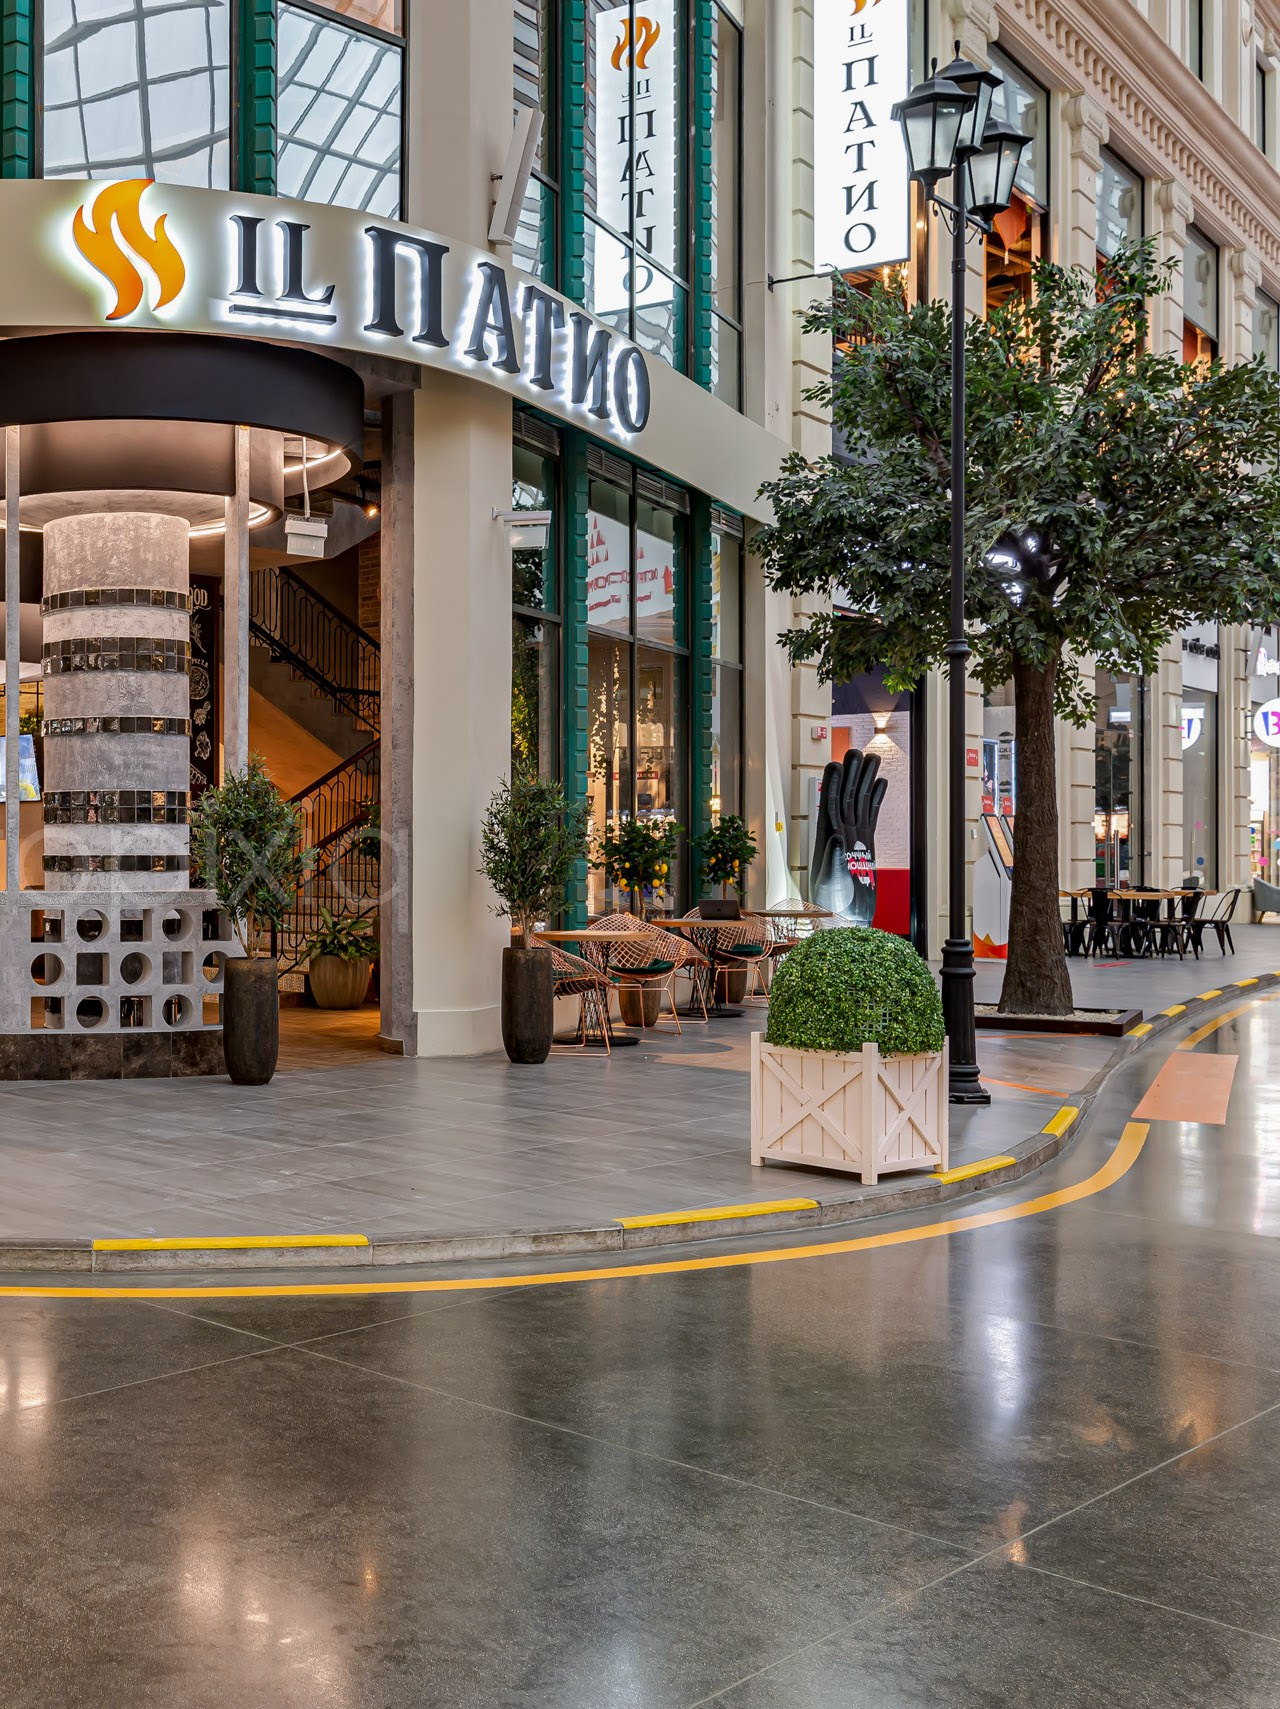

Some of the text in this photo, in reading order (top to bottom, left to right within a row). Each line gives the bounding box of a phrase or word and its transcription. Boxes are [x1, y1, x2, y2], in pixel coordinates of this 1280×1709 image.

[848, 23, 873, 43] IL
[841, 54, 879, 254] ПАТИО
[228, 214, 652, 434] IL ПАТИО
